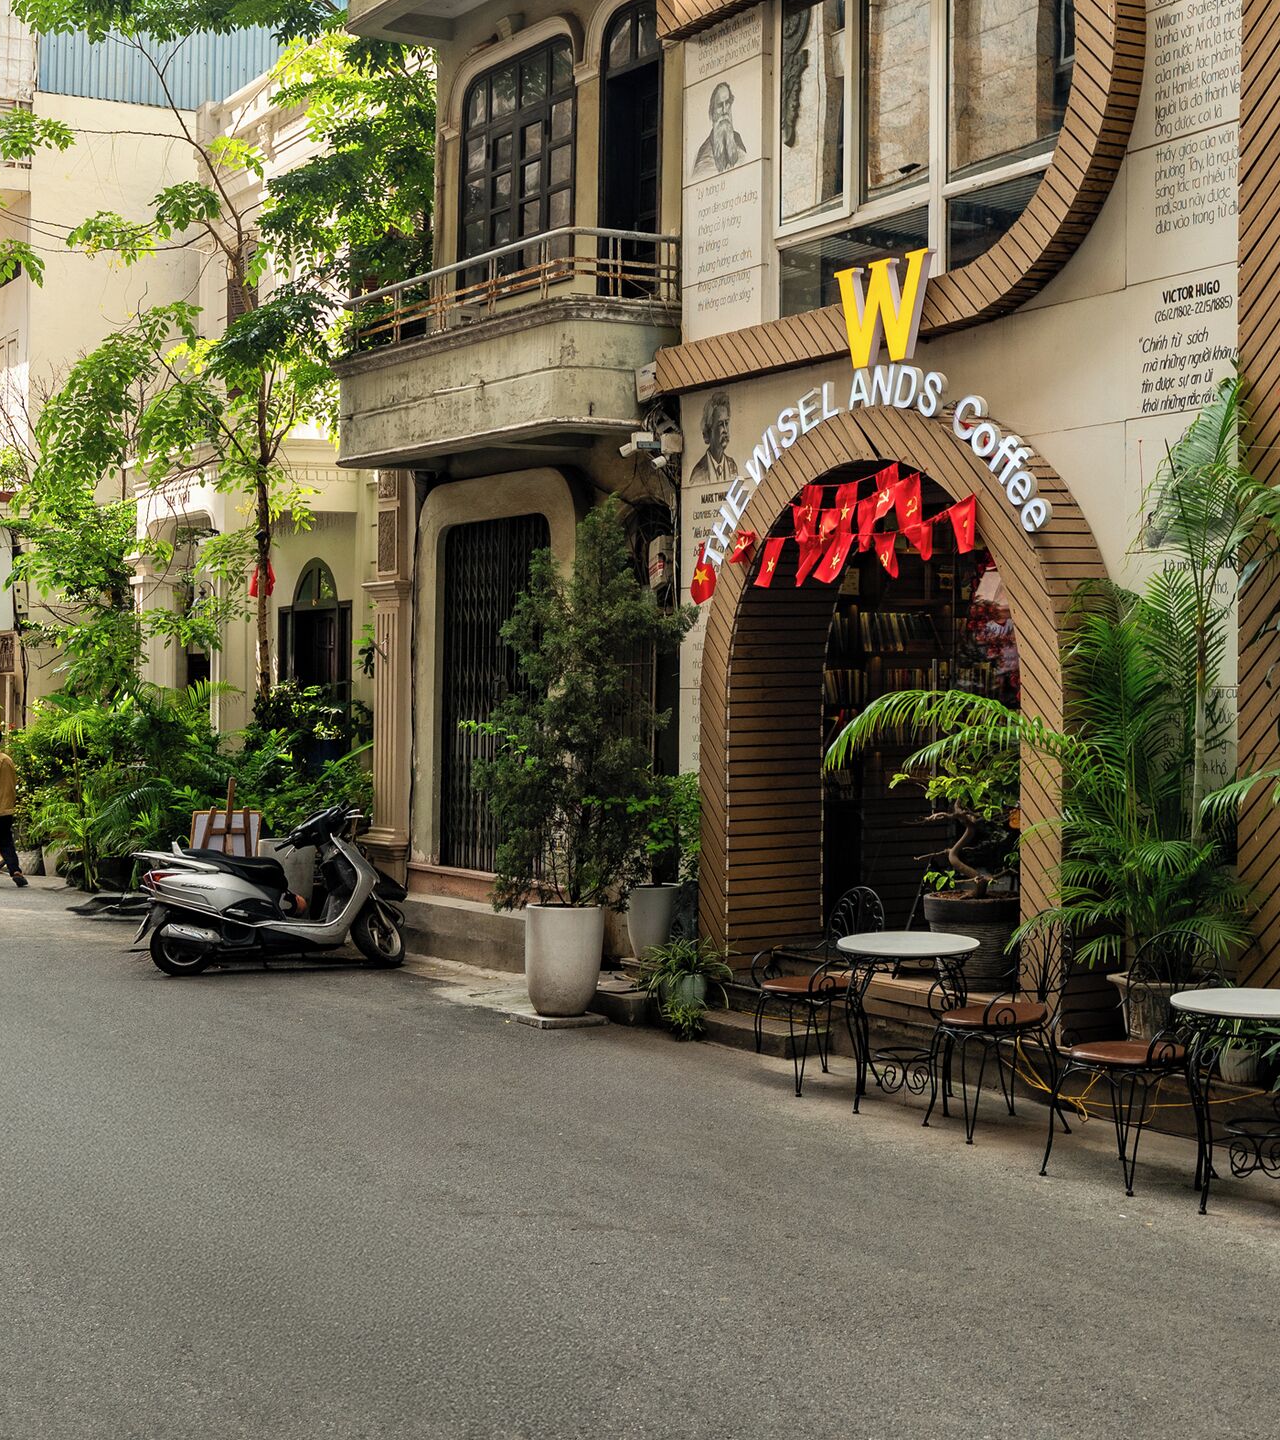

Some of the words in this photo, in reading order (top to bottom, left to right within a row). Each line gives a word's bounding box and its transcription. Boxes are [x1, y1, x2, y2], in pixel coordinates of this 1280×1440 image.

[834, 248, 938, 369] W
[1162, 285, 1194, 304] VICTOR
[1196, 280, 1220, 297] HUGO
[702, 475, 751, 566] THE
[744, 363, 949, 485] WISELANDS
[952, 394, 1053, 533] Coffee
